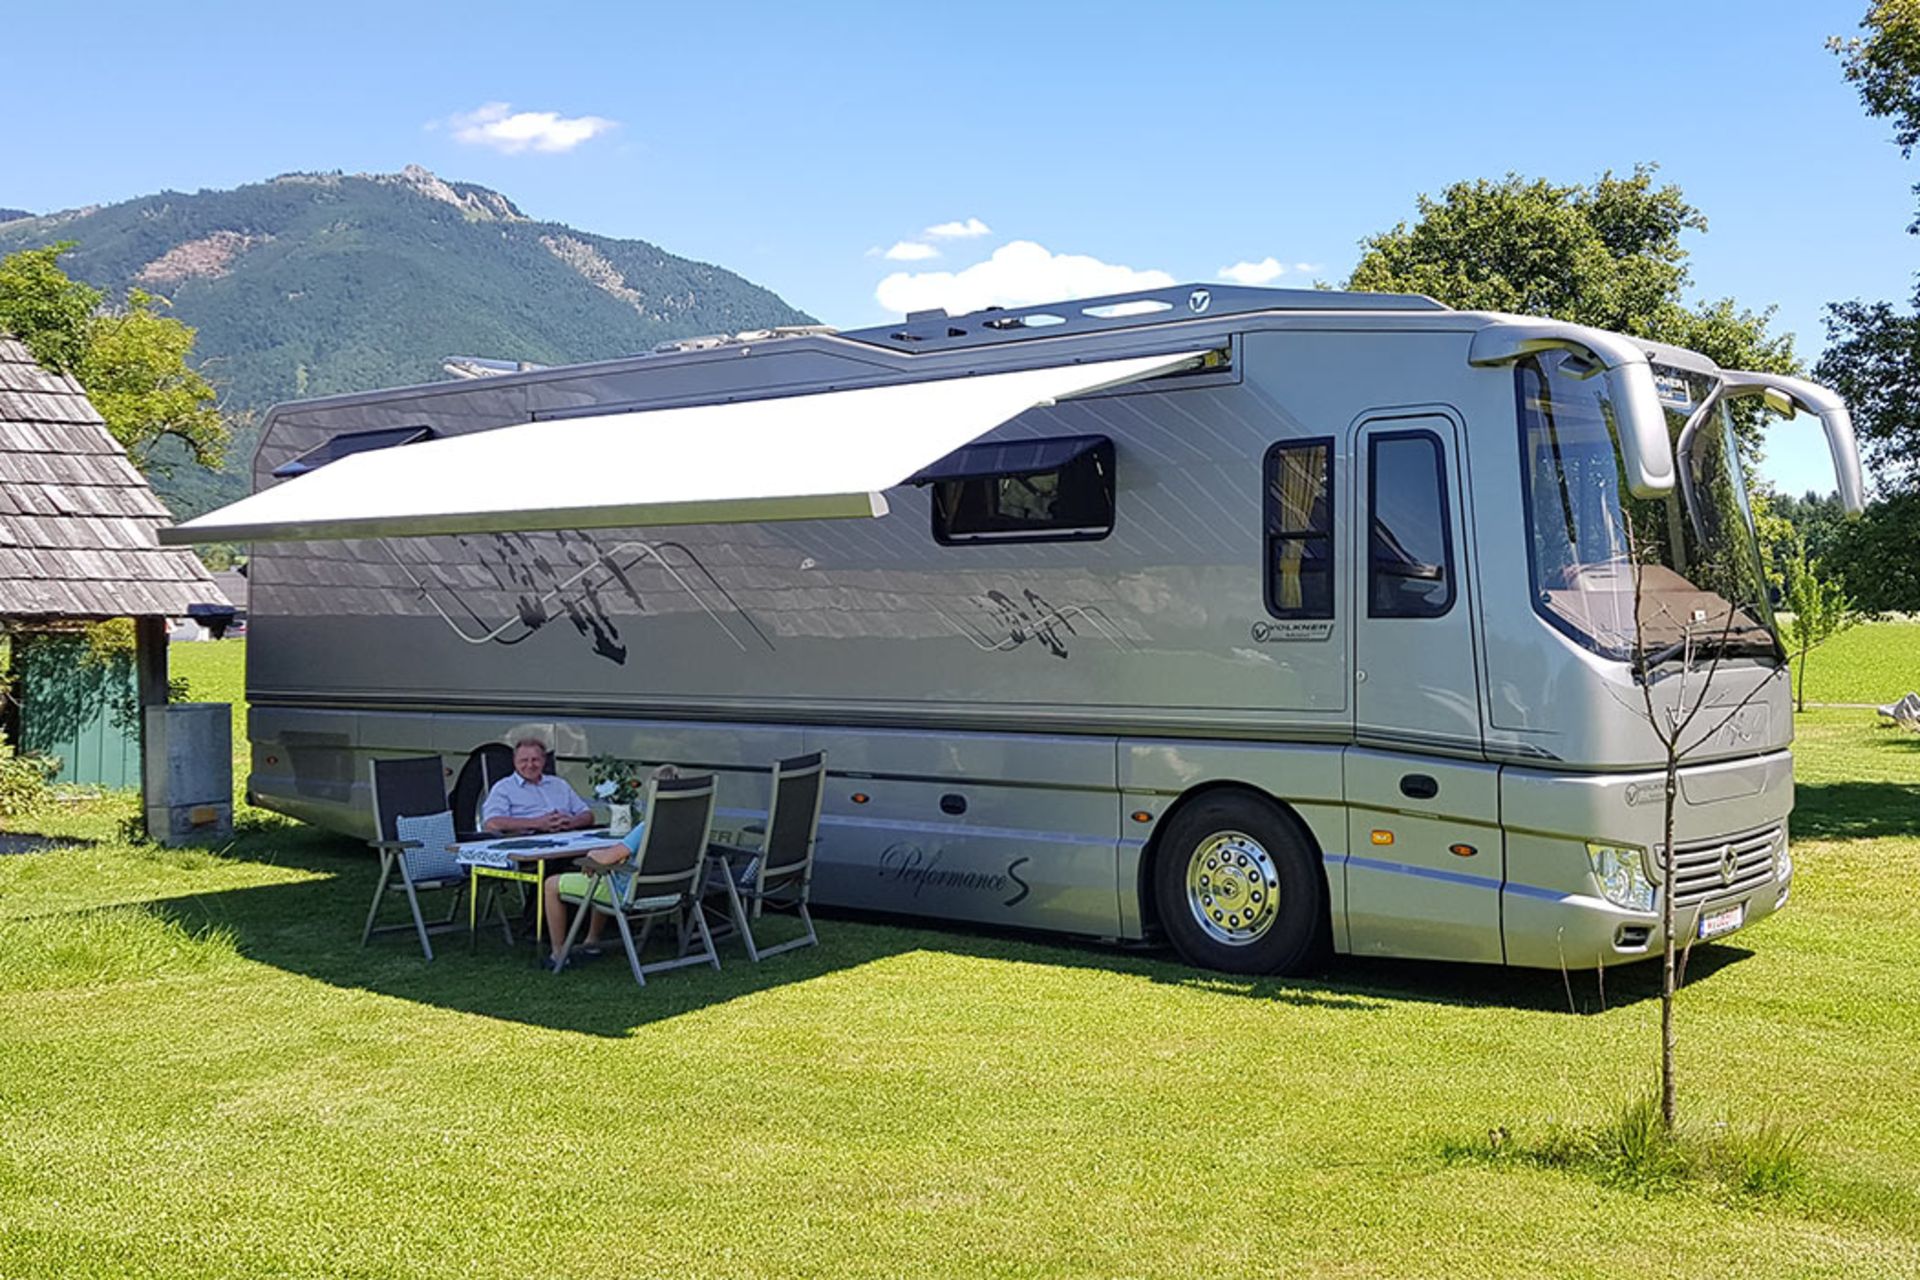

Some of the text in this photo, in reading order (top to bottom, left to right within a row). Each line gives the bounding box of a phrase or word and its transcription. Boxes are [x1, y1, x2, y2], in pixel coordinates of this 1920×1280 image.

[1268, 623, 1328, 631] VOLKNER
[878, 840, 1030, 908] Performance S
